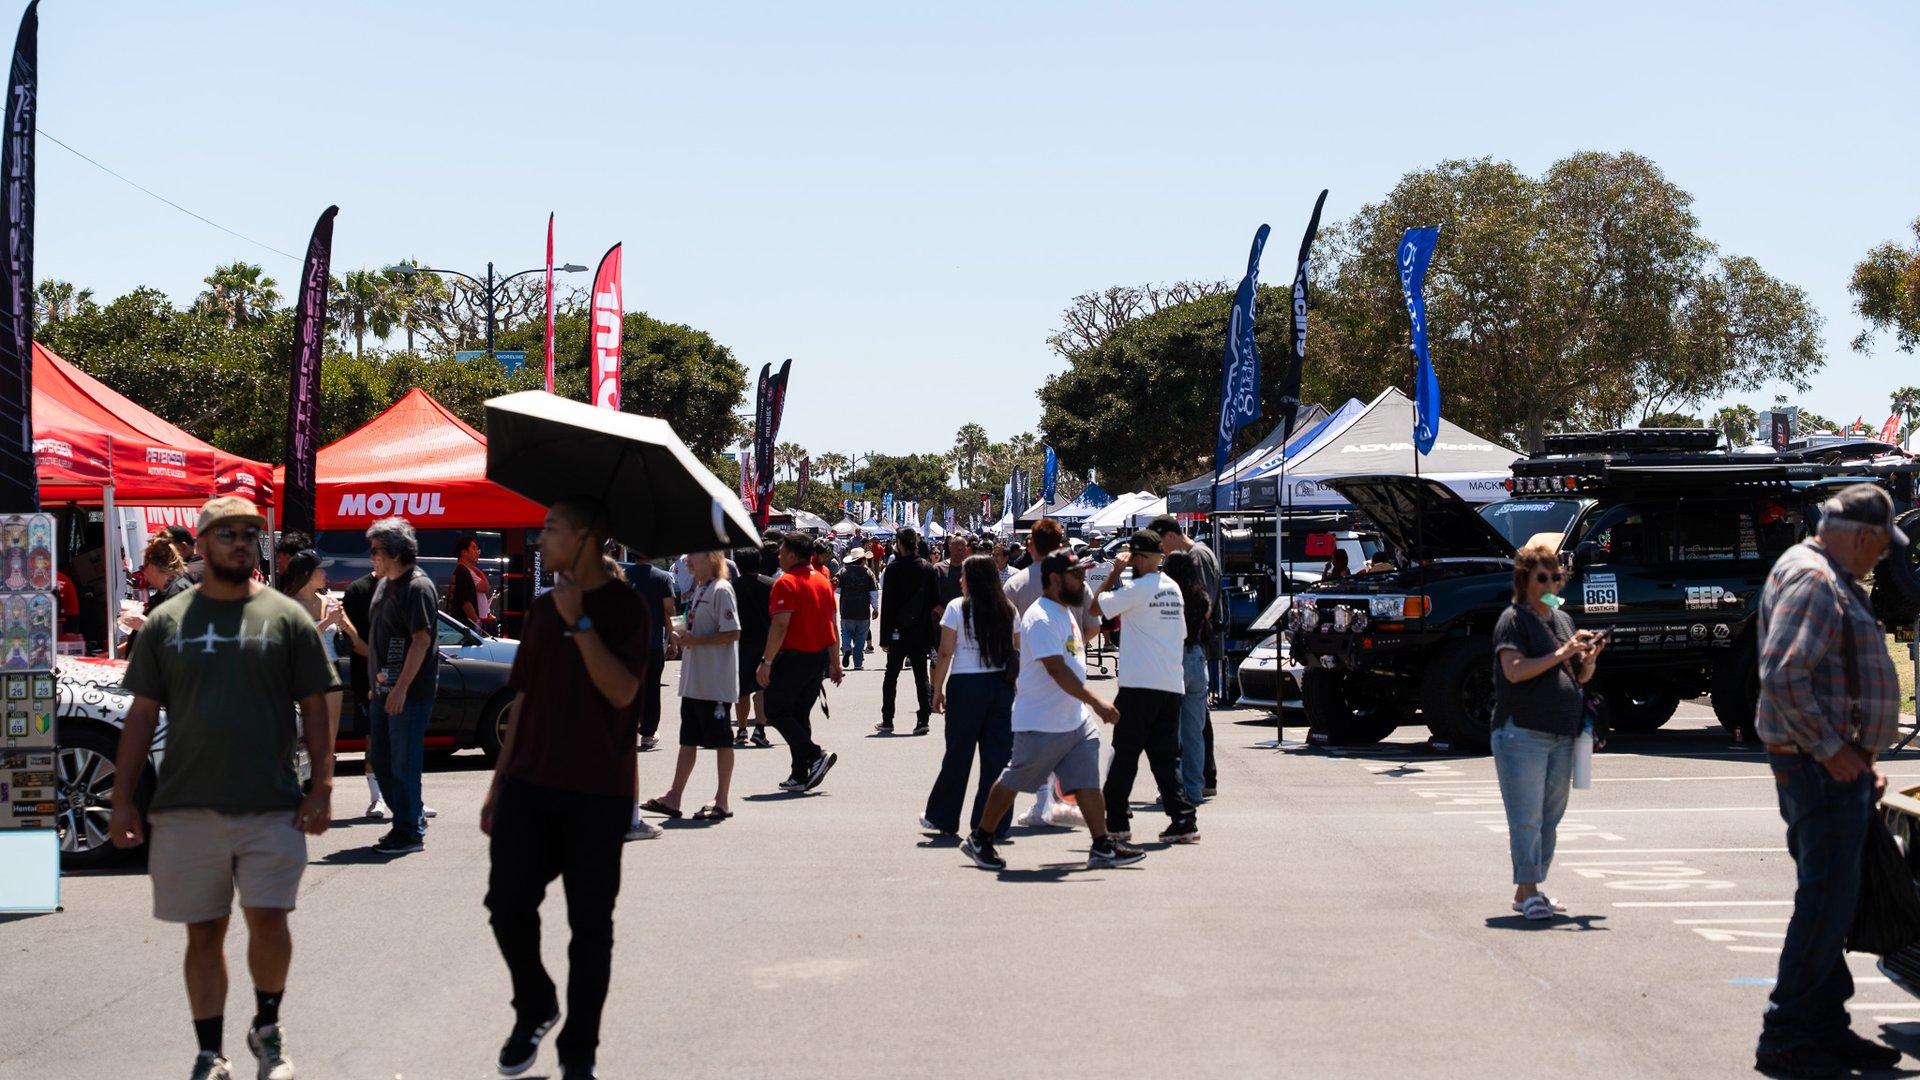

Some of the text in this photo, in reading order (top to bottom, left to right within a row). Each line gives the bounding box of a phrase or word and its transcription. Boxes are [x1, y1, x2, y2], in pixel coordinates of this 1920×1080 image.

[596, 282, 621, 411] OTUL
[146, 447, 187, 467] PETERSEN
[1341, 442, 1416, 453] ADVA
[337, 492, 446, 516] MOTUL
[1586, 589, 1616, 605] 869
[1685, 586, 1724, 604] EEP
